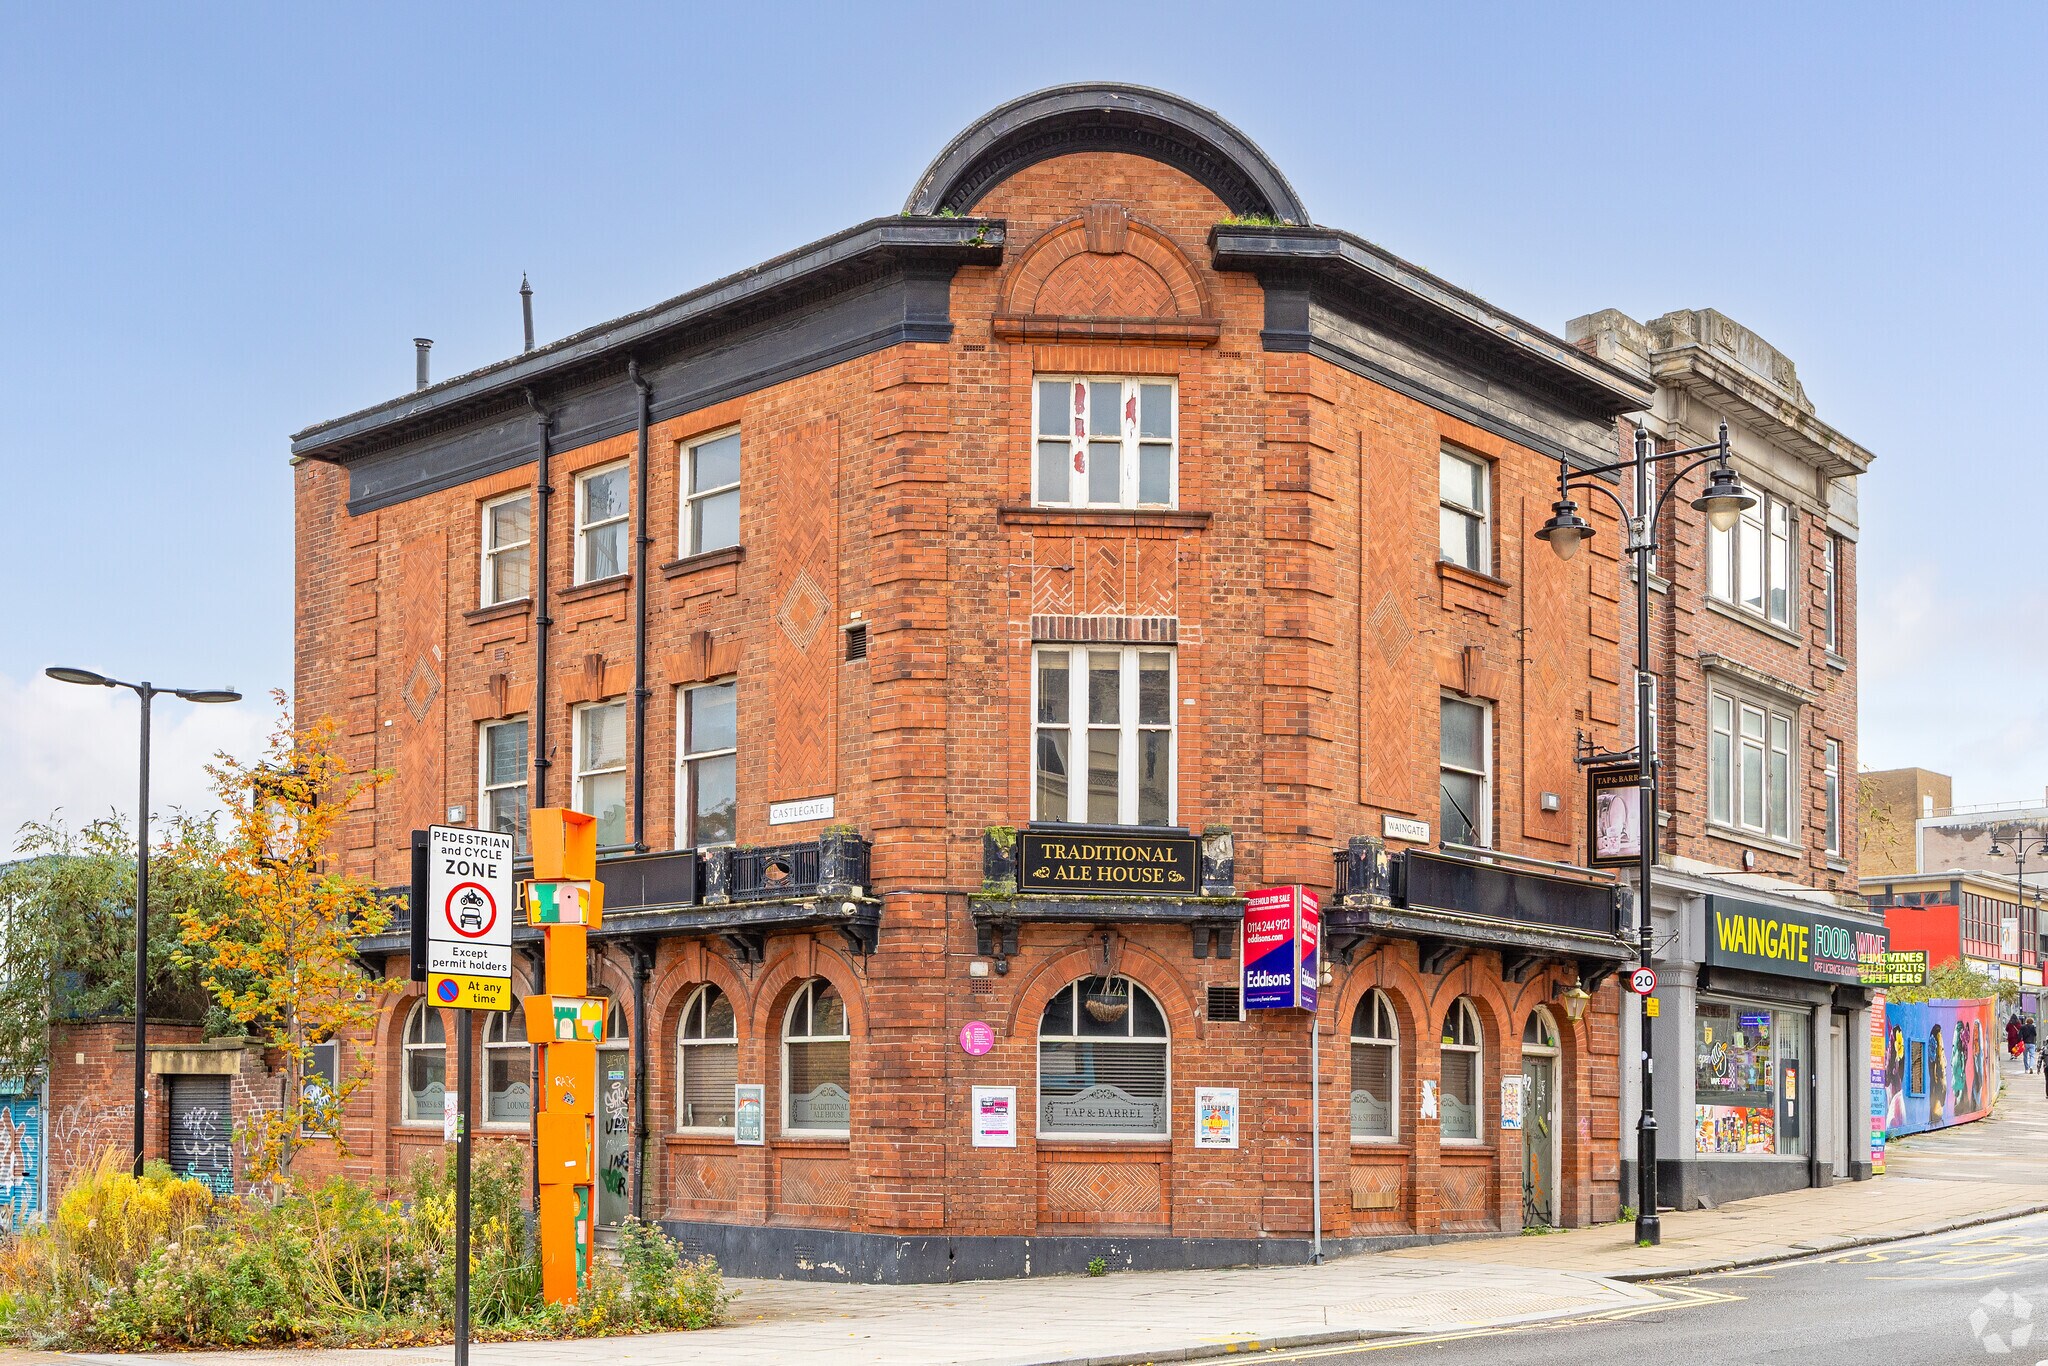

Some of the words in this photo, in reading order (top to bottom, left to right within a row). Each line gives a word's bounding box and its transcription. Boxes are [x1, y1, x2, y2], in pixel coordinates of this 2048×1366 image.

[1597, 777, 1611, 785] TAP
[1611, 776, 1618, 784] &
[1618, 774, 1640, 783] BARR
[772, 803, 824, 819] CASTLEGATE
[1388, 821, 1424, 837] WAINGATE
[433, 831, 510, 849] PEDESTRIAN
[441, 847, 461, 856] and
[464, 847, 502, 860] CYCLE
[1041, 843, 1178, 863] TRADITIONAL
[445, 859, 498, 879] ZONE
[1054, 865, 1092, 881] ALE
[1097, 866, 1164, 883] HOUSE
[1270, 895, 1278, 904] FOR
[1279, 894, 1290, 903] SALE
[1247, 922, 1261, 933] 0114
[1262, 920, 1275, 932] 244
[1275, 918, 1290, 930] 9121
[1247, 934, 1284, 943] eddisons.com
[1716, 911, 1809, 963] WAINGATE
[1814, 924, 1850, 960] FOOD
[1849, 943, 1857, 961] &
[1856, 931, 1886, 965] WINE
[452, 947, 488, 959] Except
[432, 959, 467, 969] permit
[469, 960, 508, 972] holders
[1813, 961, 1822, 972] OFF
[1822, 963, 1841, 975] LICENCE
[1889, 963, 1926, 973] PIRITS
[1247, 970, 1291, 988] Eddisons
[1635, 975, 1653, 987] 20
[467, 981, 480, 991] At
[483, 984, 502, 994] any
[473, 994, 496, 1004] time
[507, 1101, 530, 1110] LOUNGE
[810, 1103, 848, 1111] TRADITIONAL
[814, 1111, 825, 1119] ALE
[825, 1111, 845, 1119] HOUSE
[1063, 1108, 1085, 1117] TAP
[1087, 1108, 1096, 1118] &
[1098, 1108, 1144, 1119] BARREL
[1363, 1113, 1383, 1122] SPIRITS
